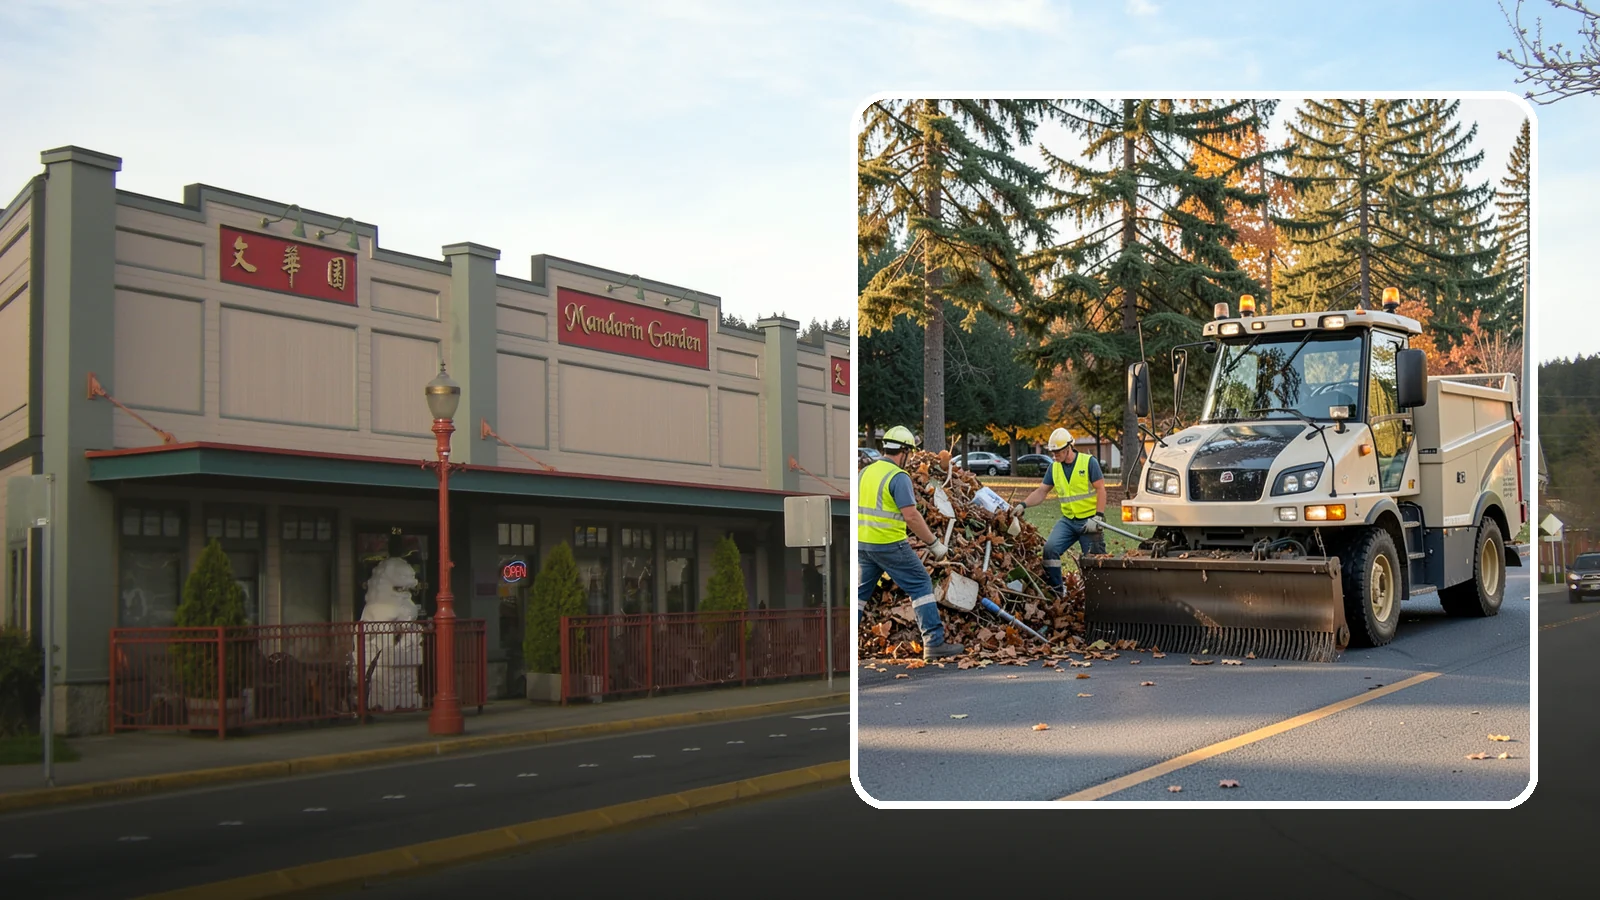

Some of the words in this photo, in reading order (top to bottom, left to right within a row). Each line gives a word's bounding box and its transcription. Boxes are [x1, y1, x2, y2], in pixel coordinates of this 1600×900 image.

[564, 302, 644, 341] Mandarin
[647, 320, 701, 352] Garden
[503, 565, 527, 578] OPEN
